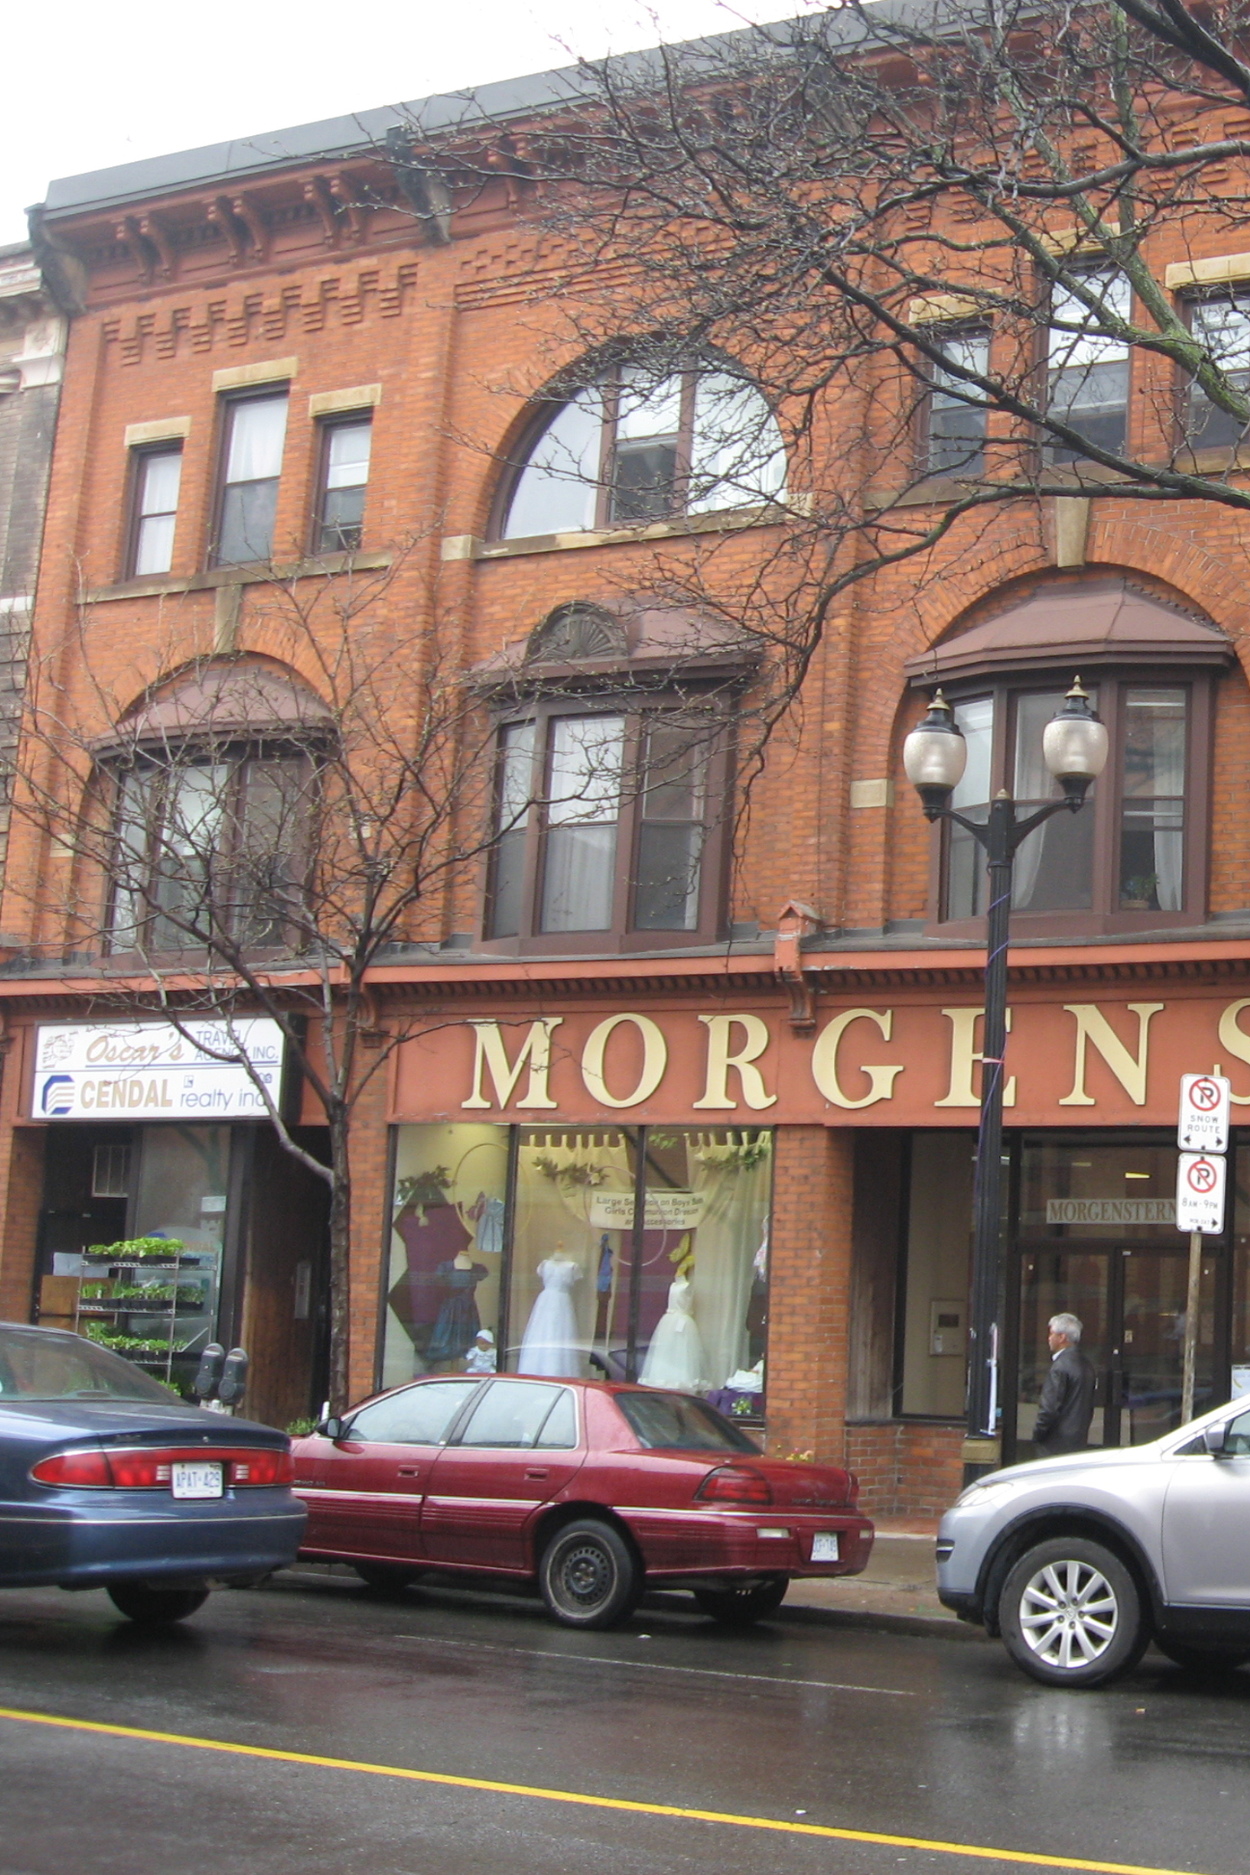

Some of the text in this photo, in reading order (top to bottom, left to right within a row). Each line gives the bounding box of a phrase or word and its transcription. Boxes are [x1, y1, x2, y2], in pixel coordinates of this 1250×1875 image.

[86, 1032, 185, 1062] Oscar's
[253, 1046, 279, 1060] INC.
[81, 1079, 173, 1109] CENDAL
[180, 1089, 233, 1111] realty
[1190, 1115, 1218, 1124] SNOW
[1187, 1124, 1220, 1134] ROUTE
